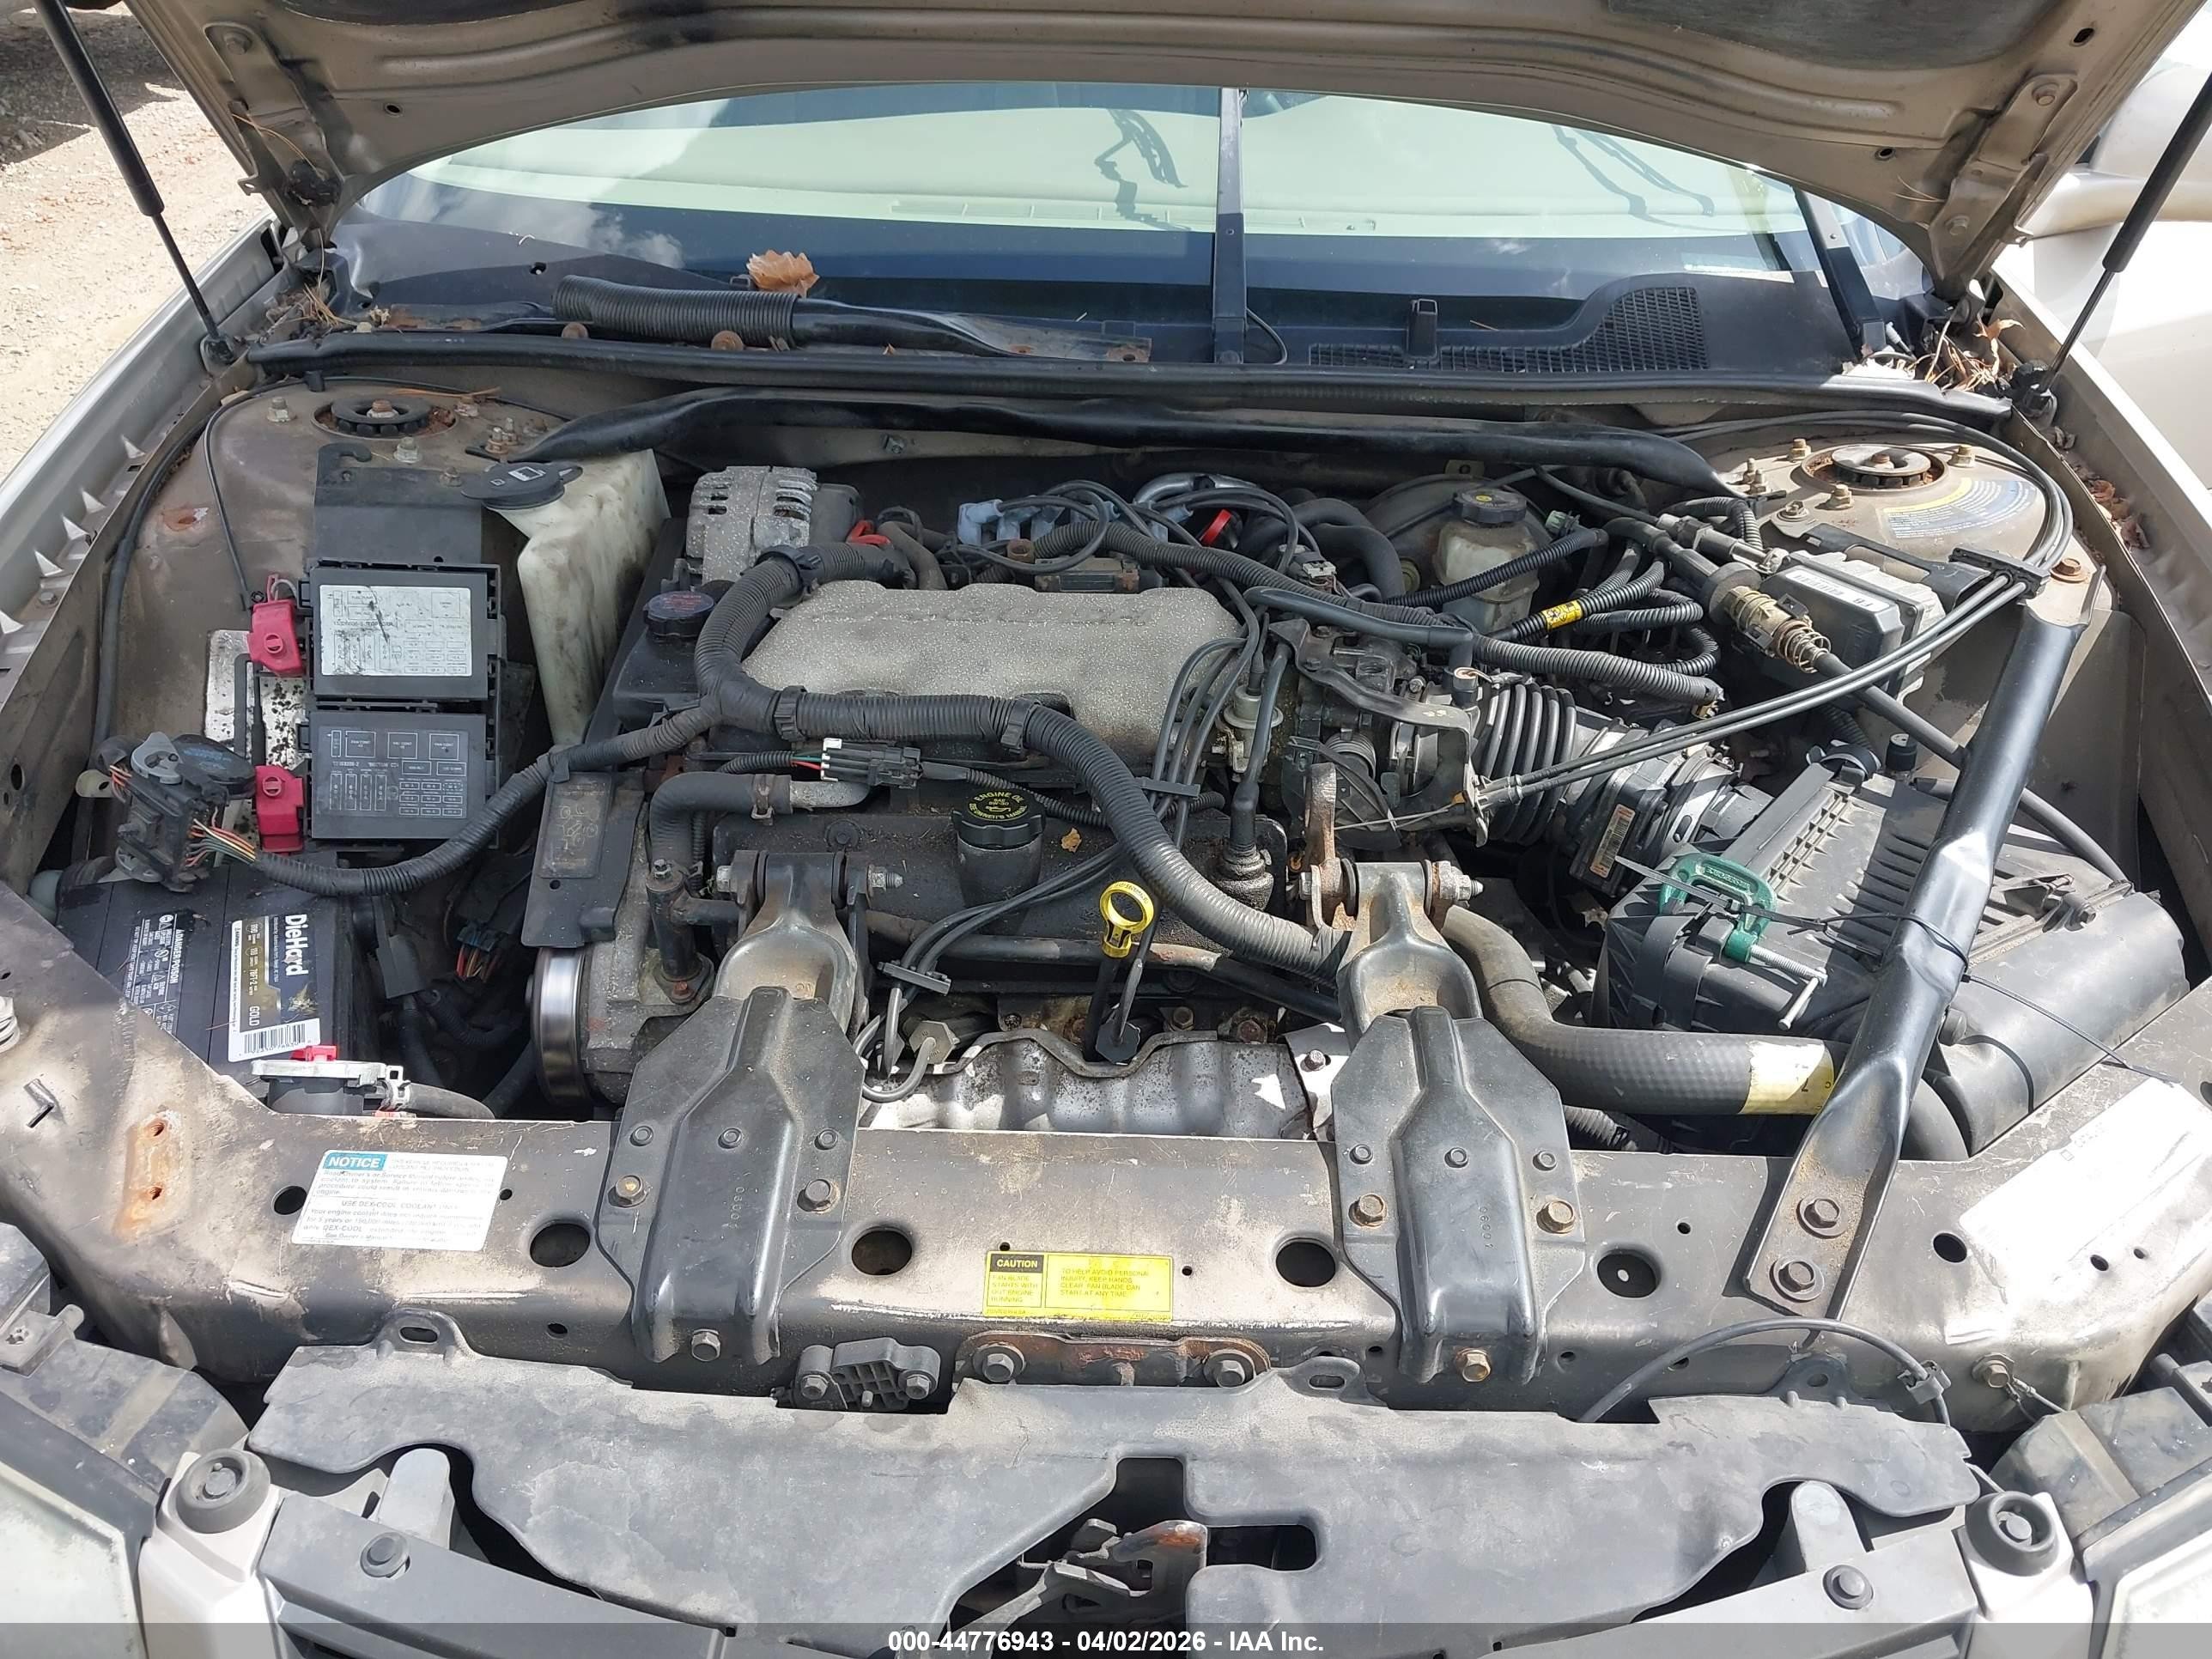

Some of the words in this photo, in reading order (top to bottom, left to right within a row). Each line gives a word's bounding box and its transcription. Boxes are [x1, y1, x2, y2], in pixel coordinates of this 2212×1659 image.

[974, 792, 1012, 801] ENGINE
[285, 914, 309, 975] DieHard
[249, 1006, 260, 1026] GOLD
[328, 1157, 380, 1169] NOTICE
[996, 1259, 1038, 1268] CAUTION
